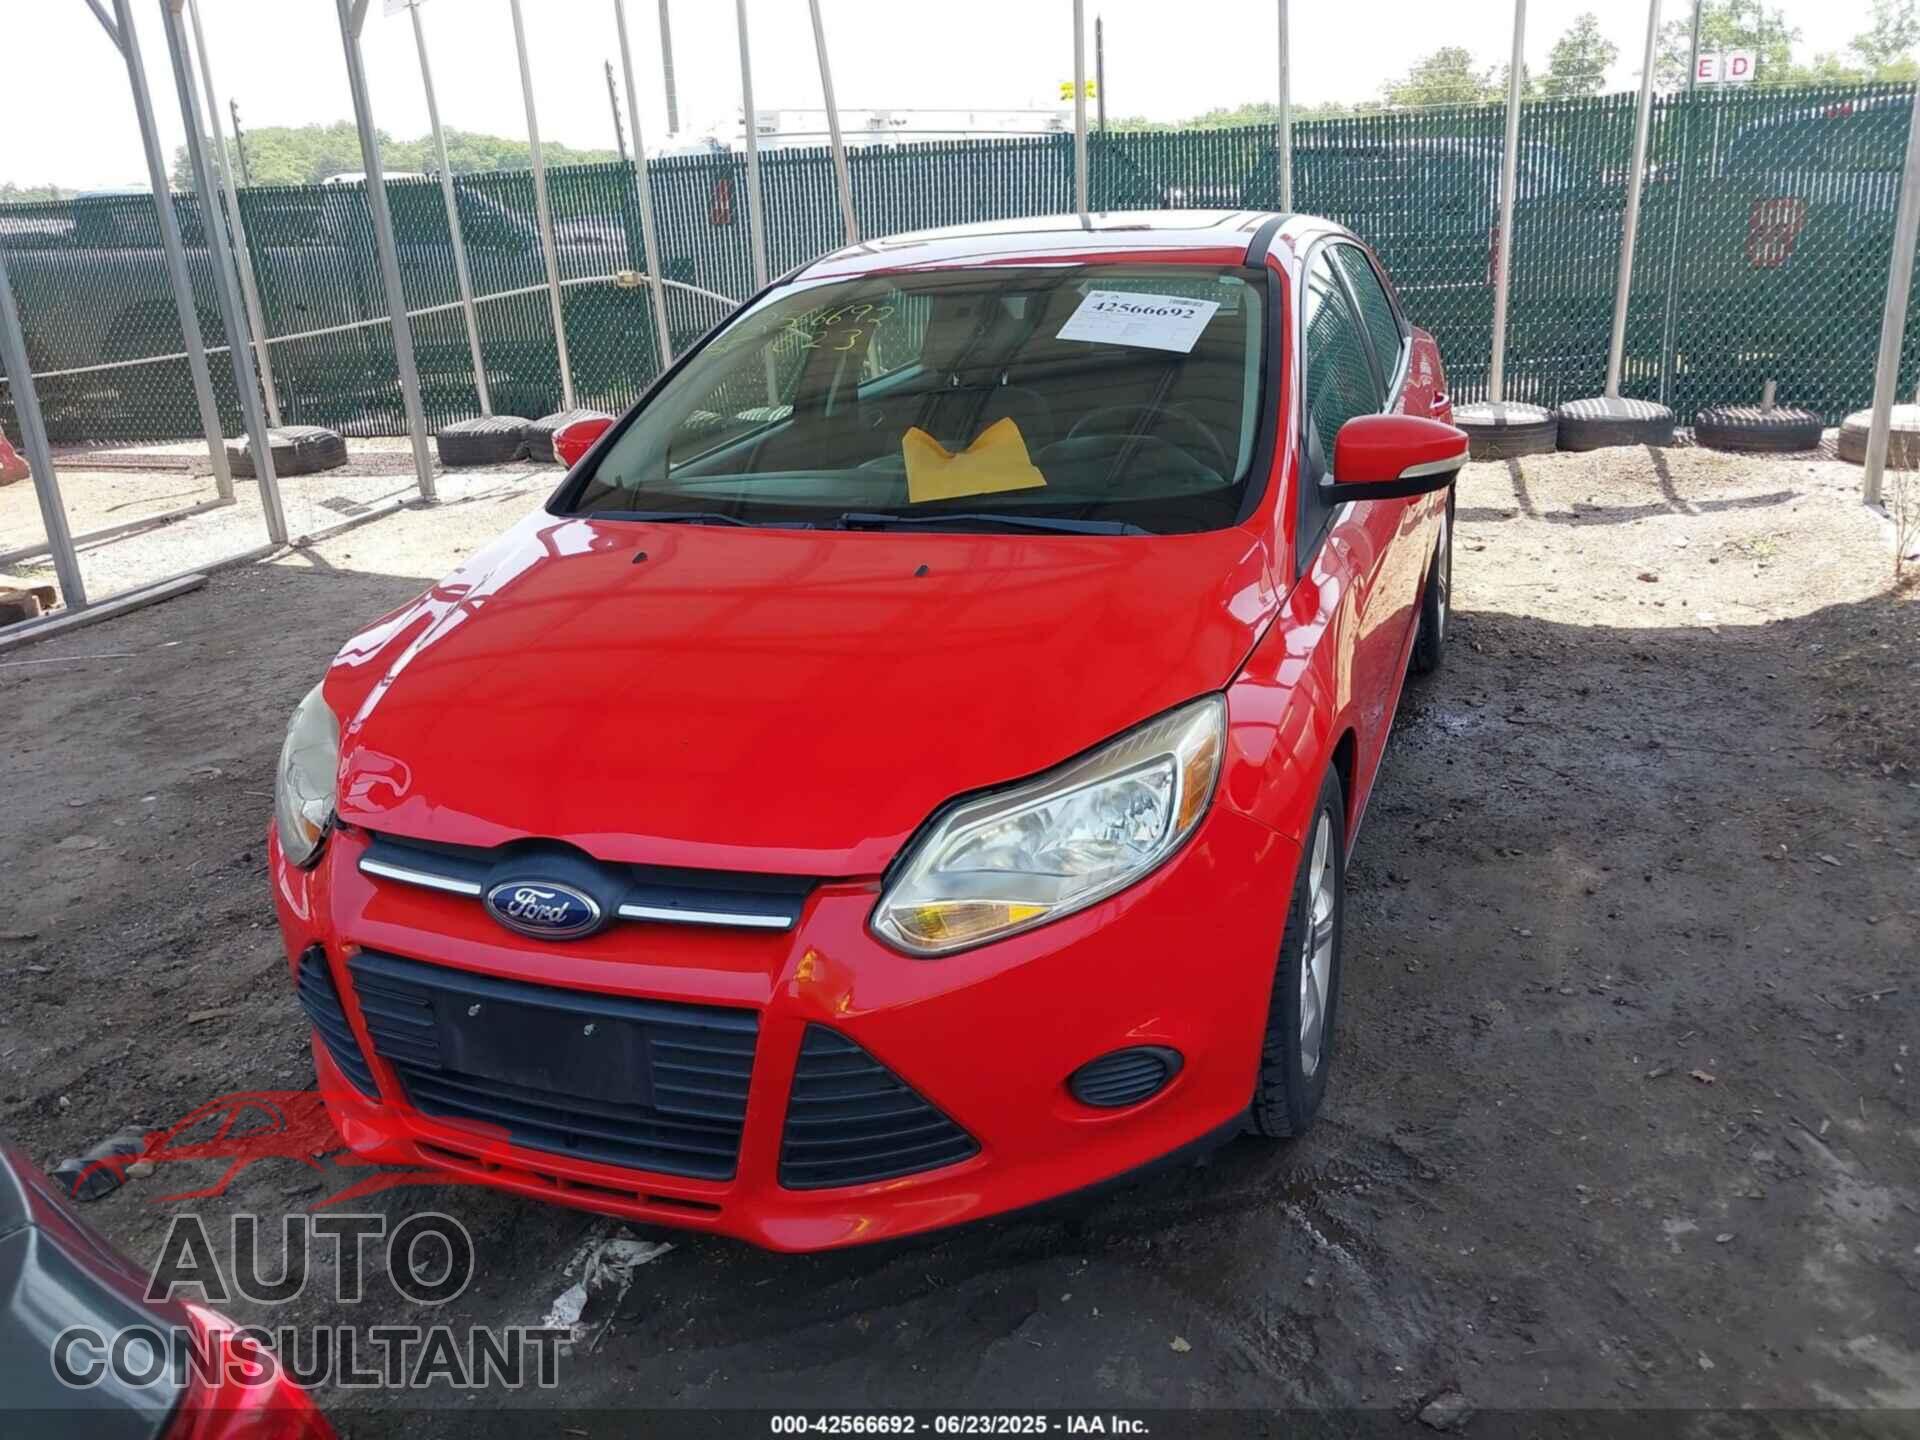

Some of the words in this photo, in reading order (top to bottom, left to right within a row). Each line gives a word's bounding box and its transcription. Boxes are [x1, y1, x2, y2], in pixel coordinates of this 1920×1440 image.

[1698, 59, 1713, 78] E
[1731, 57, 1748, 76] D
[1092, 301, 1195, 319] 42566692
[508, 887, 570, 922] Ford
